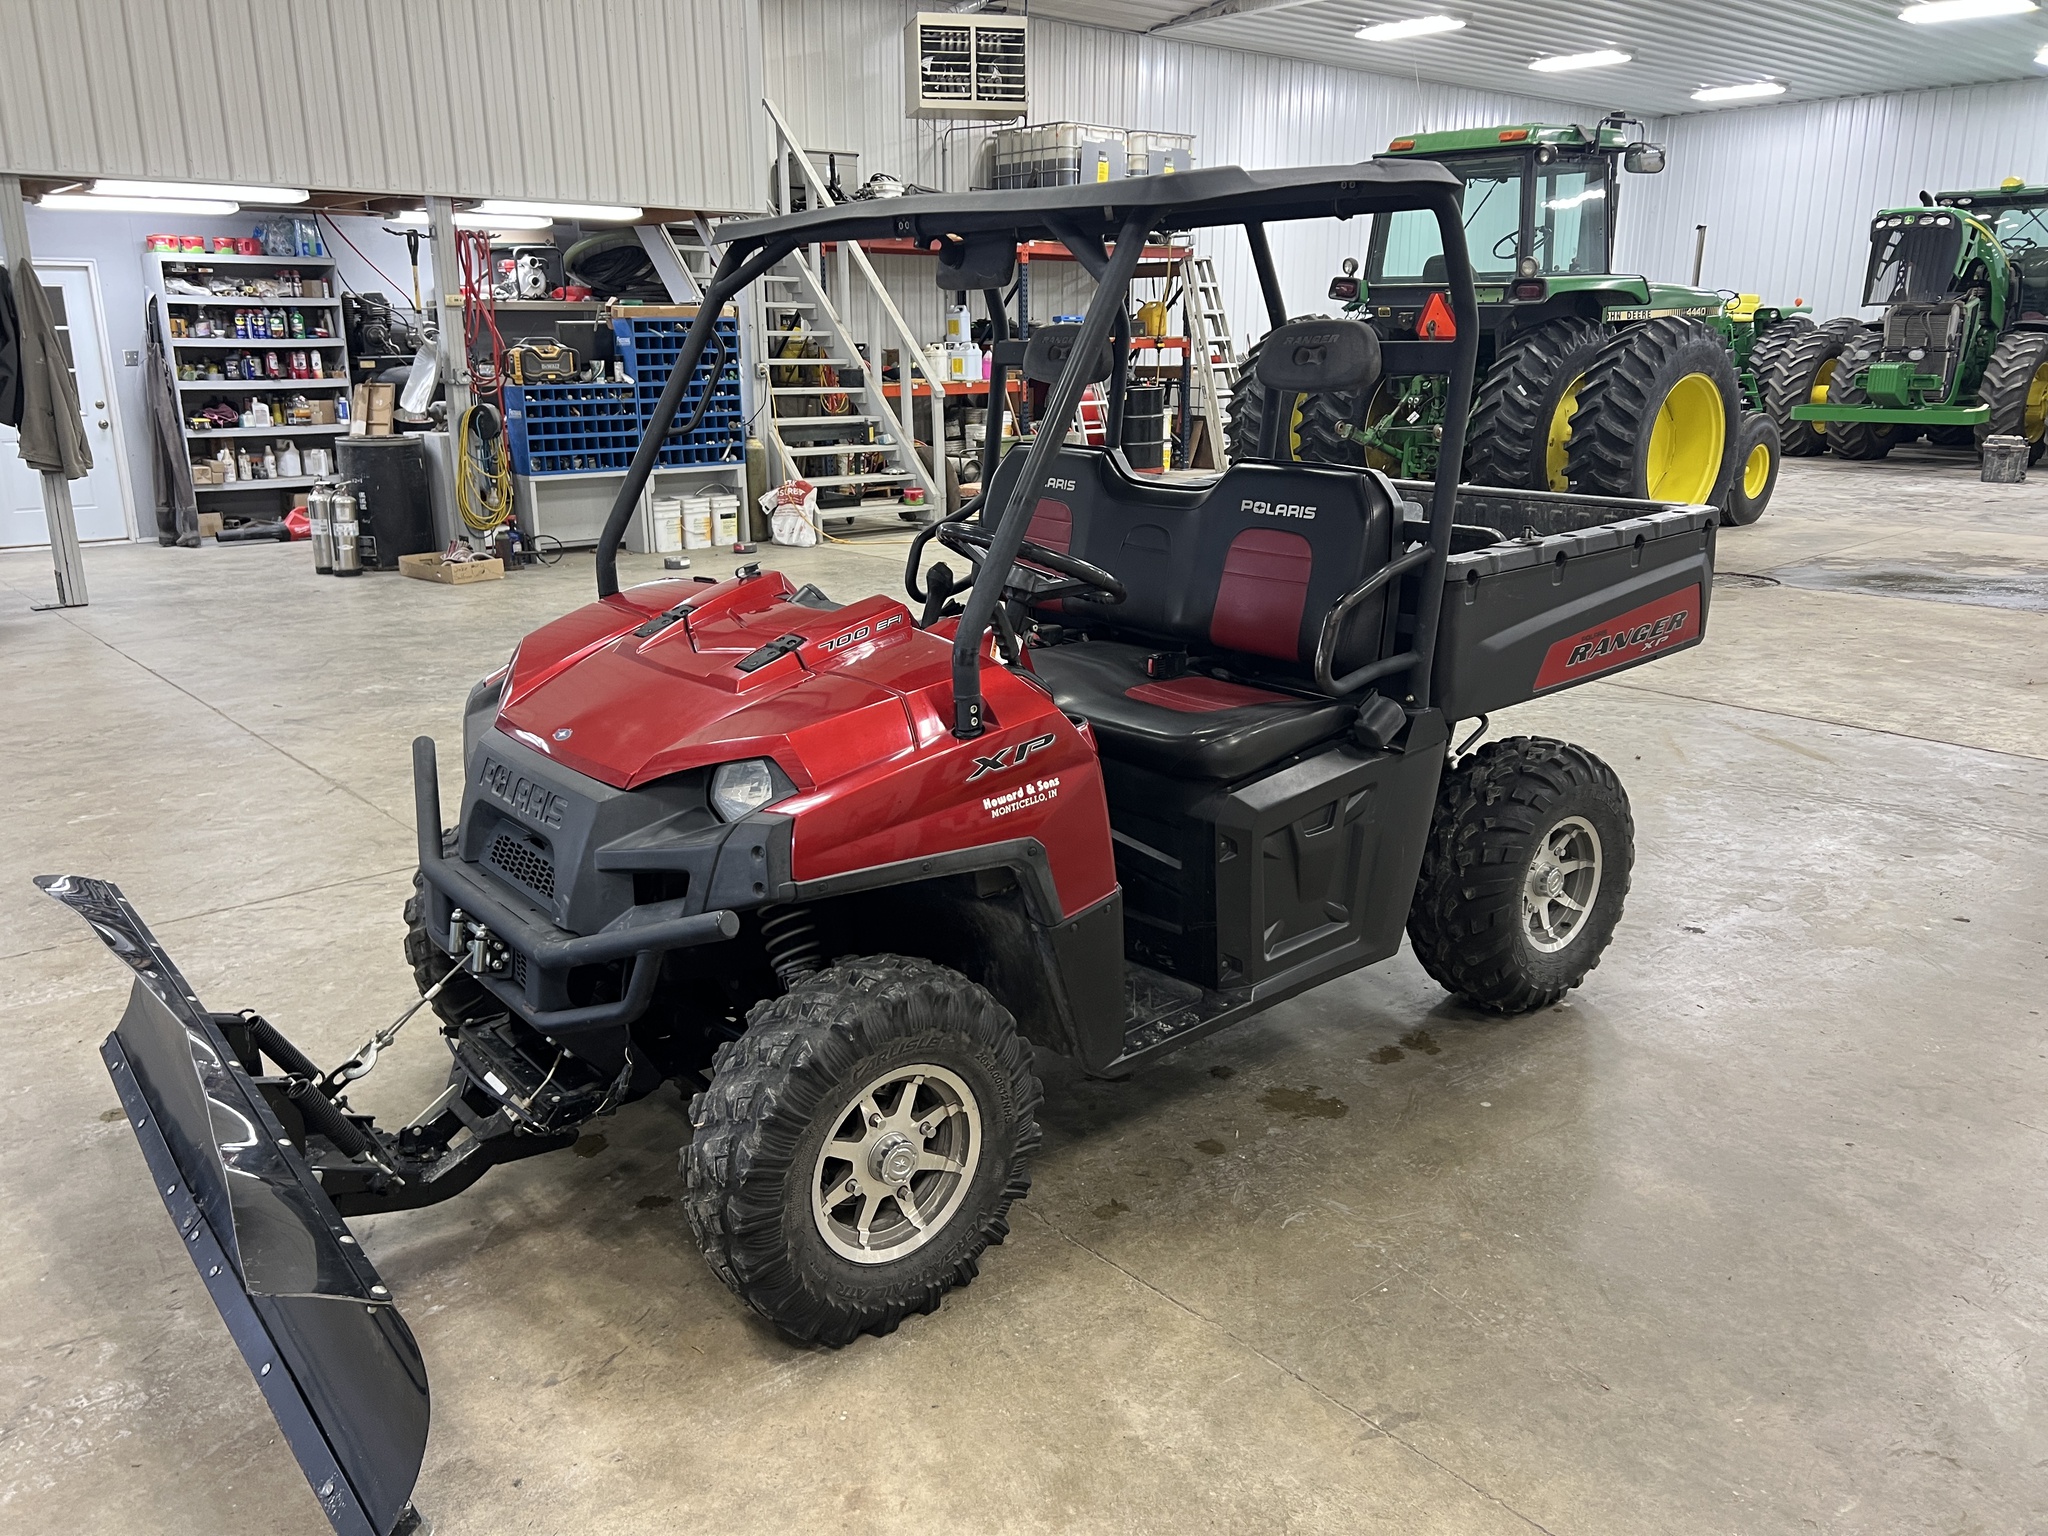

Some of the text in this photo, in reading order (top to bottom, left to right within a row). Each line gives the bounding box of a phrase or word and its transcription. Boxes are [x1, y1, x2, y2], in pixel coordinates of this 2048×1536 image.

[1627, 310, 1651, 320] DEERE
[1686, 307, 1706, 316] 4440
[1041, 336, 1076, 344] RANGE
[1282, 333, 1340, 345] RANGER
[1240, 499, 1317, 519] POLARIS
[817, 614, 902, 653] 700 EFI
[1565, 610, 1688, 667] RANGER
[1641, 635, 1669, 652] XP
[966, 733, 1055, 782] XP
[479, 757, 568, 829] POLARIS
[983, 777, 1060, 809] Howard & Sons
[991, 788, 1058, 818] MONTICELLO, IN
